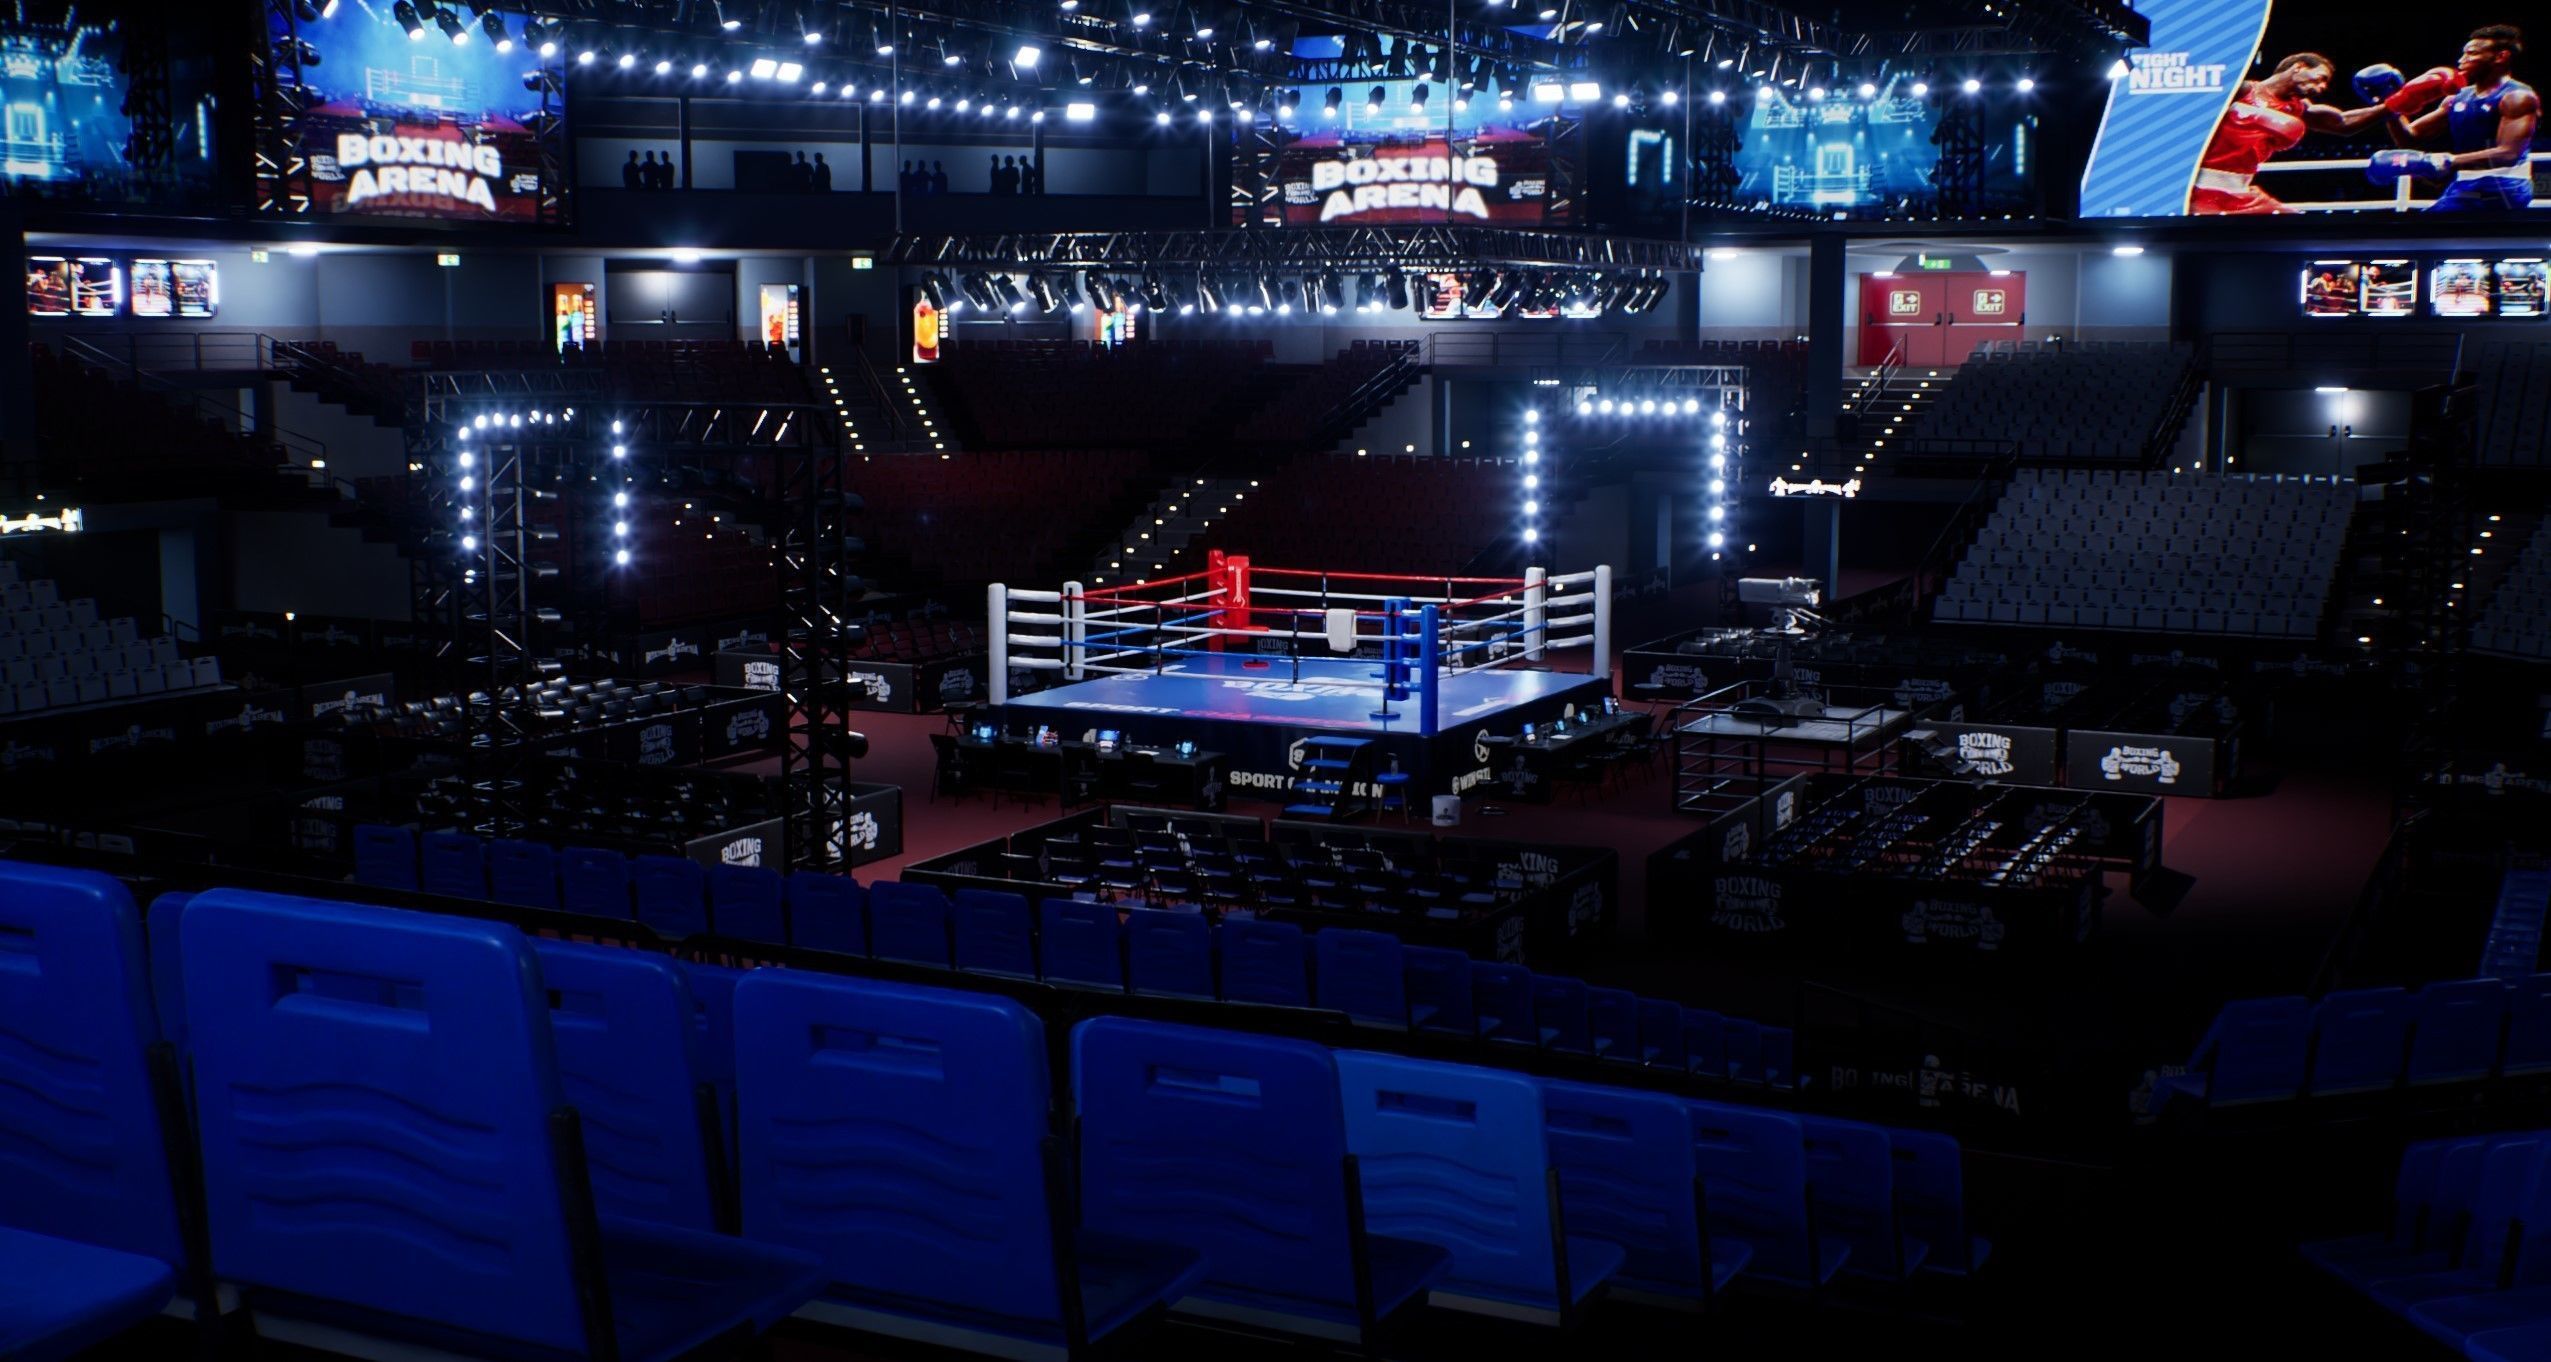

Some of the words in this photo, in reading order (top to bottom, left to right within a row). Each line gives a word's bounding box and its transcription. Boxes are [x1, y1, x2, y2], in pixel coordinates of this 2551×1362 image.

[2129, 65, 2226, 89] NIGHT
[337, 133, 501, 178] BOXING
[1313, 157, 1498, 191] BOXING
[346, 165, 496, 212] ARENA
[1320, 183, 1489, 223] ARENA
[1892, 303, 1917, 313] EXIT
[1976, 303, 2001, 313] EXIT
[1959, 732, 2012, 750] BOXING
[2122, 745, 2159, 758] BOXING
[1229, 770, 1285, 790] SPORT
[2120, 762, 2161, 776] WORLD
[1863, 785, 1913, 803] BOXIN
[721, 837, 762, 863] BOXING
[1715, 876, 1783, 899] BOXING
[1711, 911, 1787, 933] WORLD
